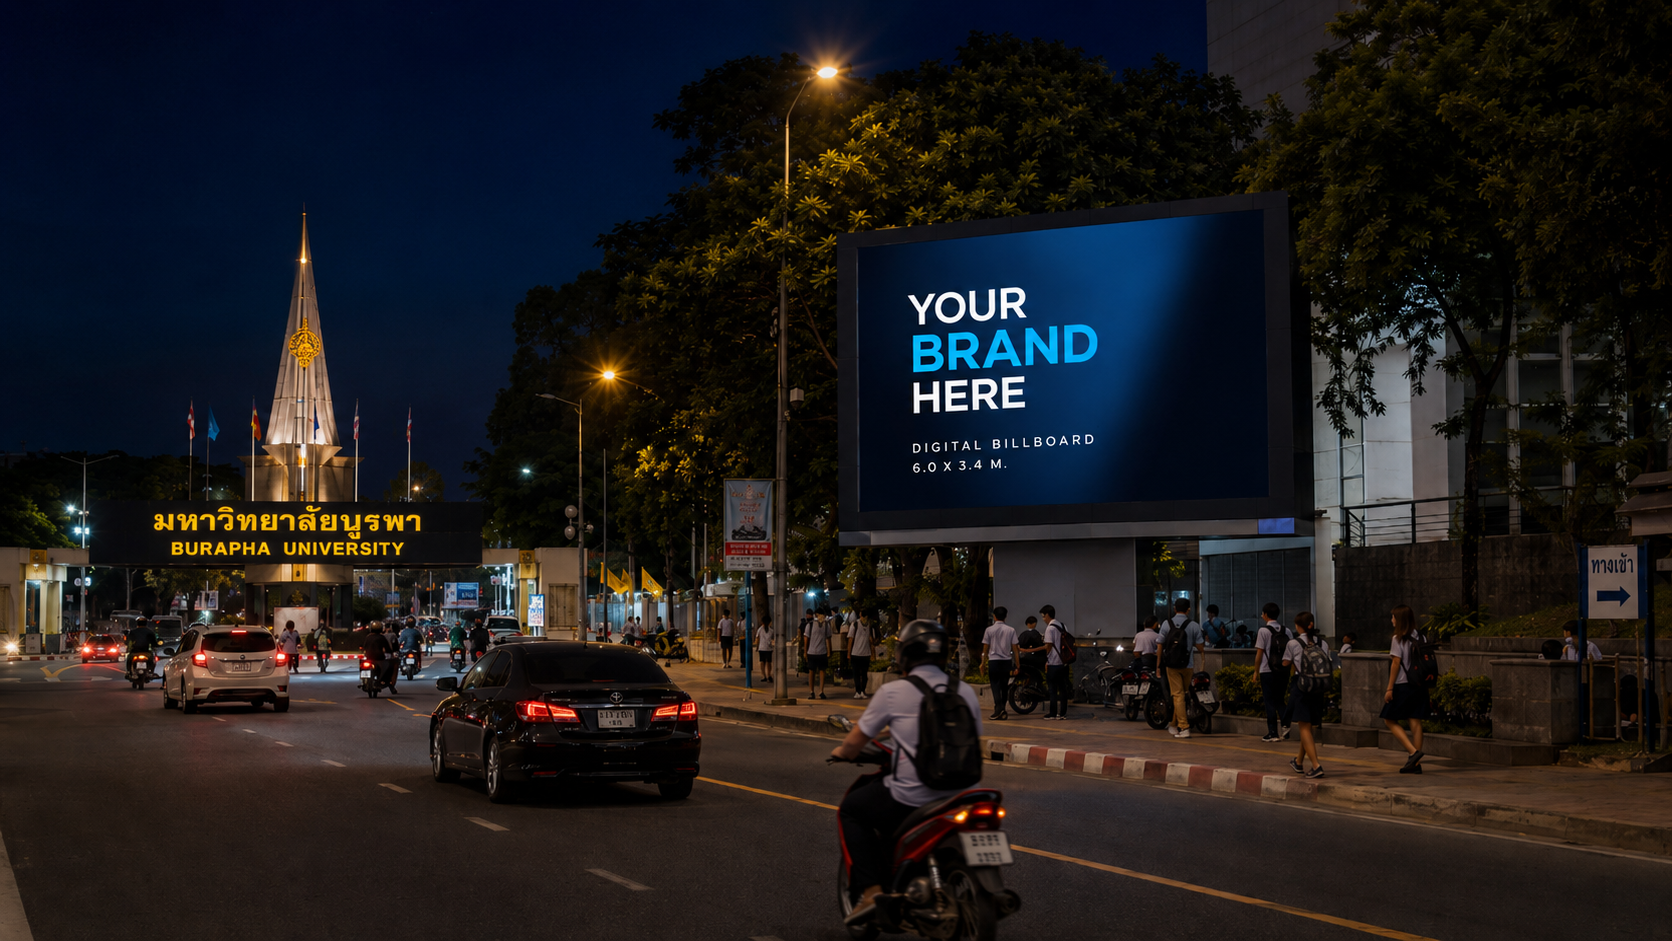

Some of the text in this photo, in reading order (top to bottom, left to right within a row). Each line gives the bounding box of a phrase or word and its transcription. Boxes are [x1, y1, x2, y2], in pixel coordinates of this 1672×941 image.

[907, 286, 1027, 325] YOUR
[912, 324, 1098, 373] BRAND
[912, 375, 1026, 414] HERE
[912, 434, 1095, 454] DIGITAL BILLBOARD
[912, 458, 1007, 474] 6.0 X 3.4 M.
[171, 541, 405, 556] BURAPHA UNIVERSITY
[1591, 552, 1634, 574] ทางเข้า
